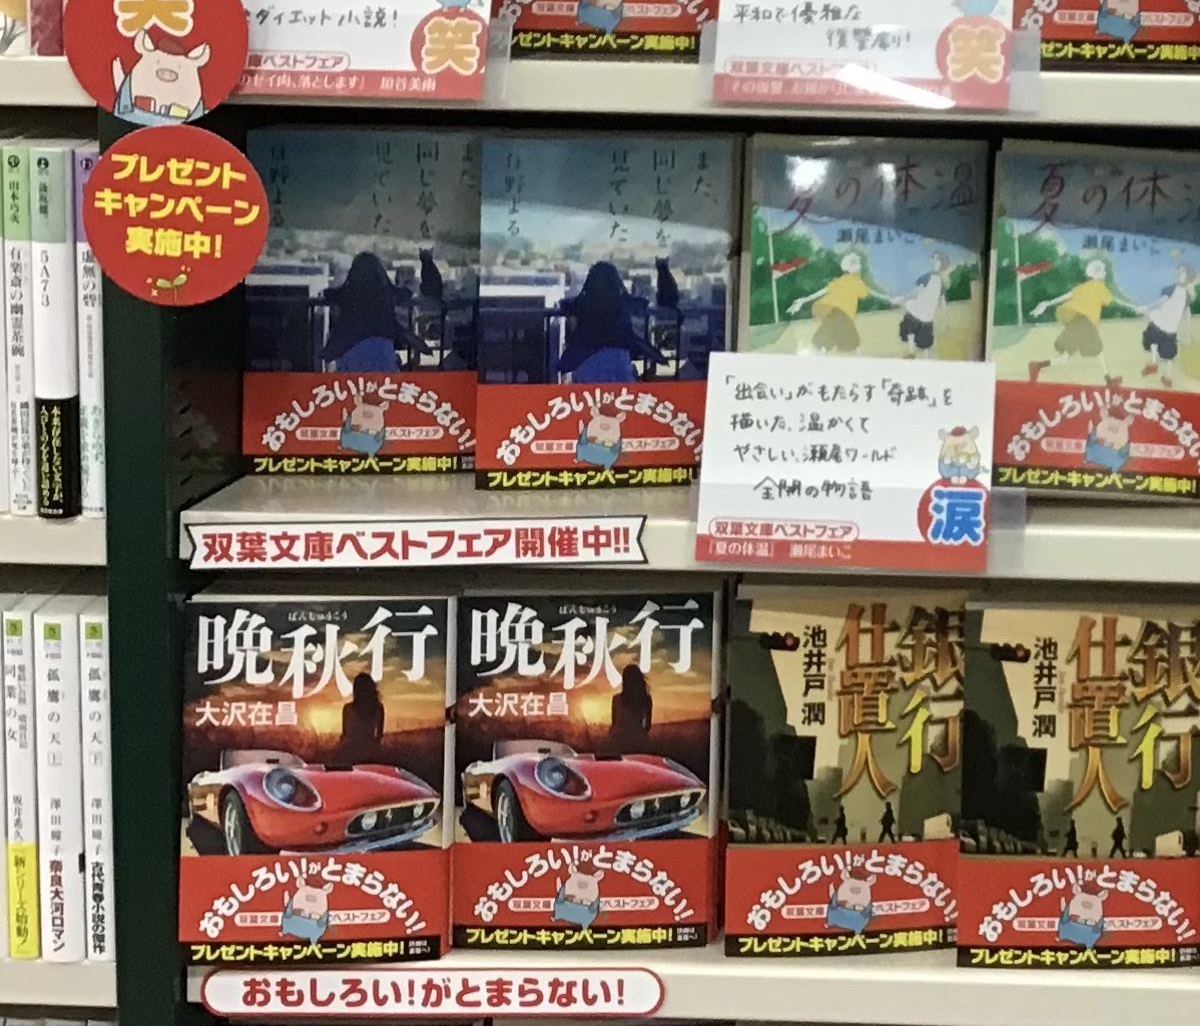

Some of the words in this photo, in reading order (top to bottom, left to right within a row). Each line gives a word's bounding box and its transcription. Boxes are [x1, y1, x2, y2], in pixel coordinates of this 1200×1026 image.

[423, 18, 480, 74] 笑
[110, 154, 247, 190] プレゼント
[94, 189, 260, 226] キャンペーン
[931, 489, 986, 544] 涙
[197, 604, 438, 700] 晩秋行
[470, 599, 705, 690] 晩秋行
[195, 701, 298, 727] 大沢在昌
[468, 691, 569, 718] 大沢在昌
[1065, 615, 1129, 813] 仕置人
